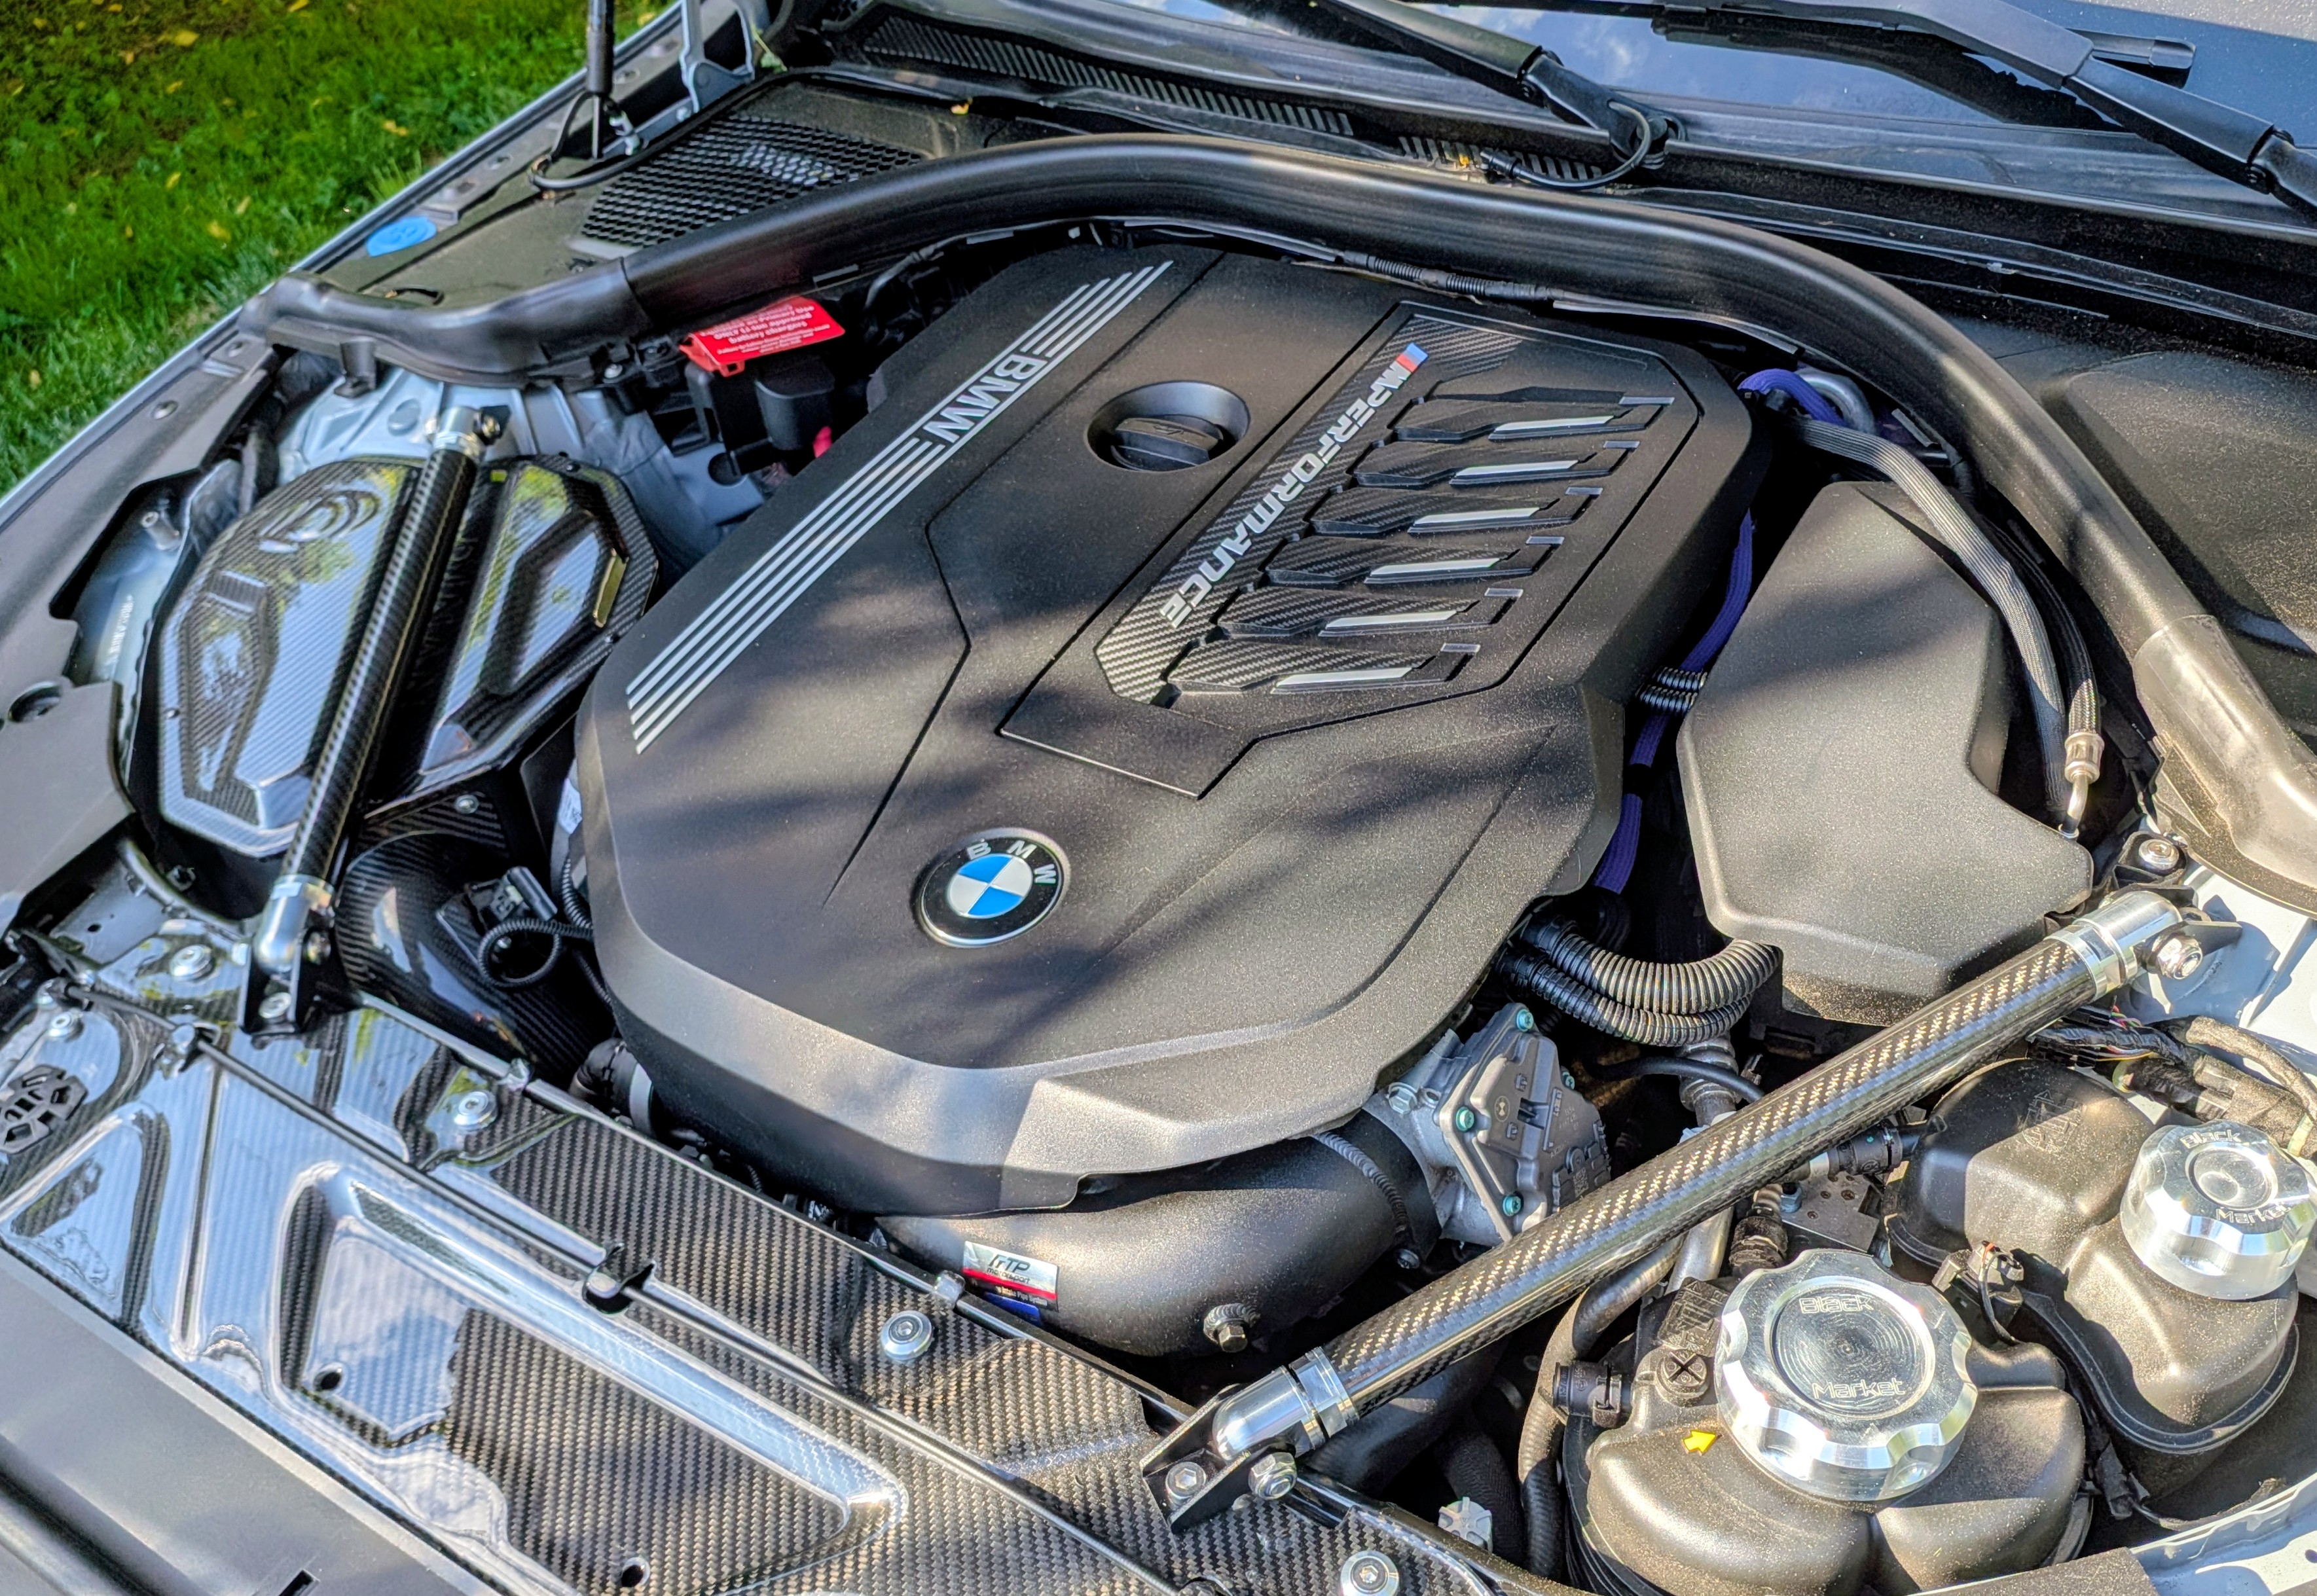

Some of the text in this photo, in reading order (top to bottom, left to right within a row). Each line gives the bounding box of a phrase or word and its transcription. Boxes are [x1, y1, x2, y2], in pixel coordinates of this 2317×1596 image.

[923, 354, 1048, 443] BMW
[966, 840, 1056, 884] BMW
[2180, 1129, 2242, 1149] Black
[2216, 1203, 2291, 1224] Market
[1798, 1294, 1874, 1314] Black
[1812, 1378, 1906, 1400] Market
